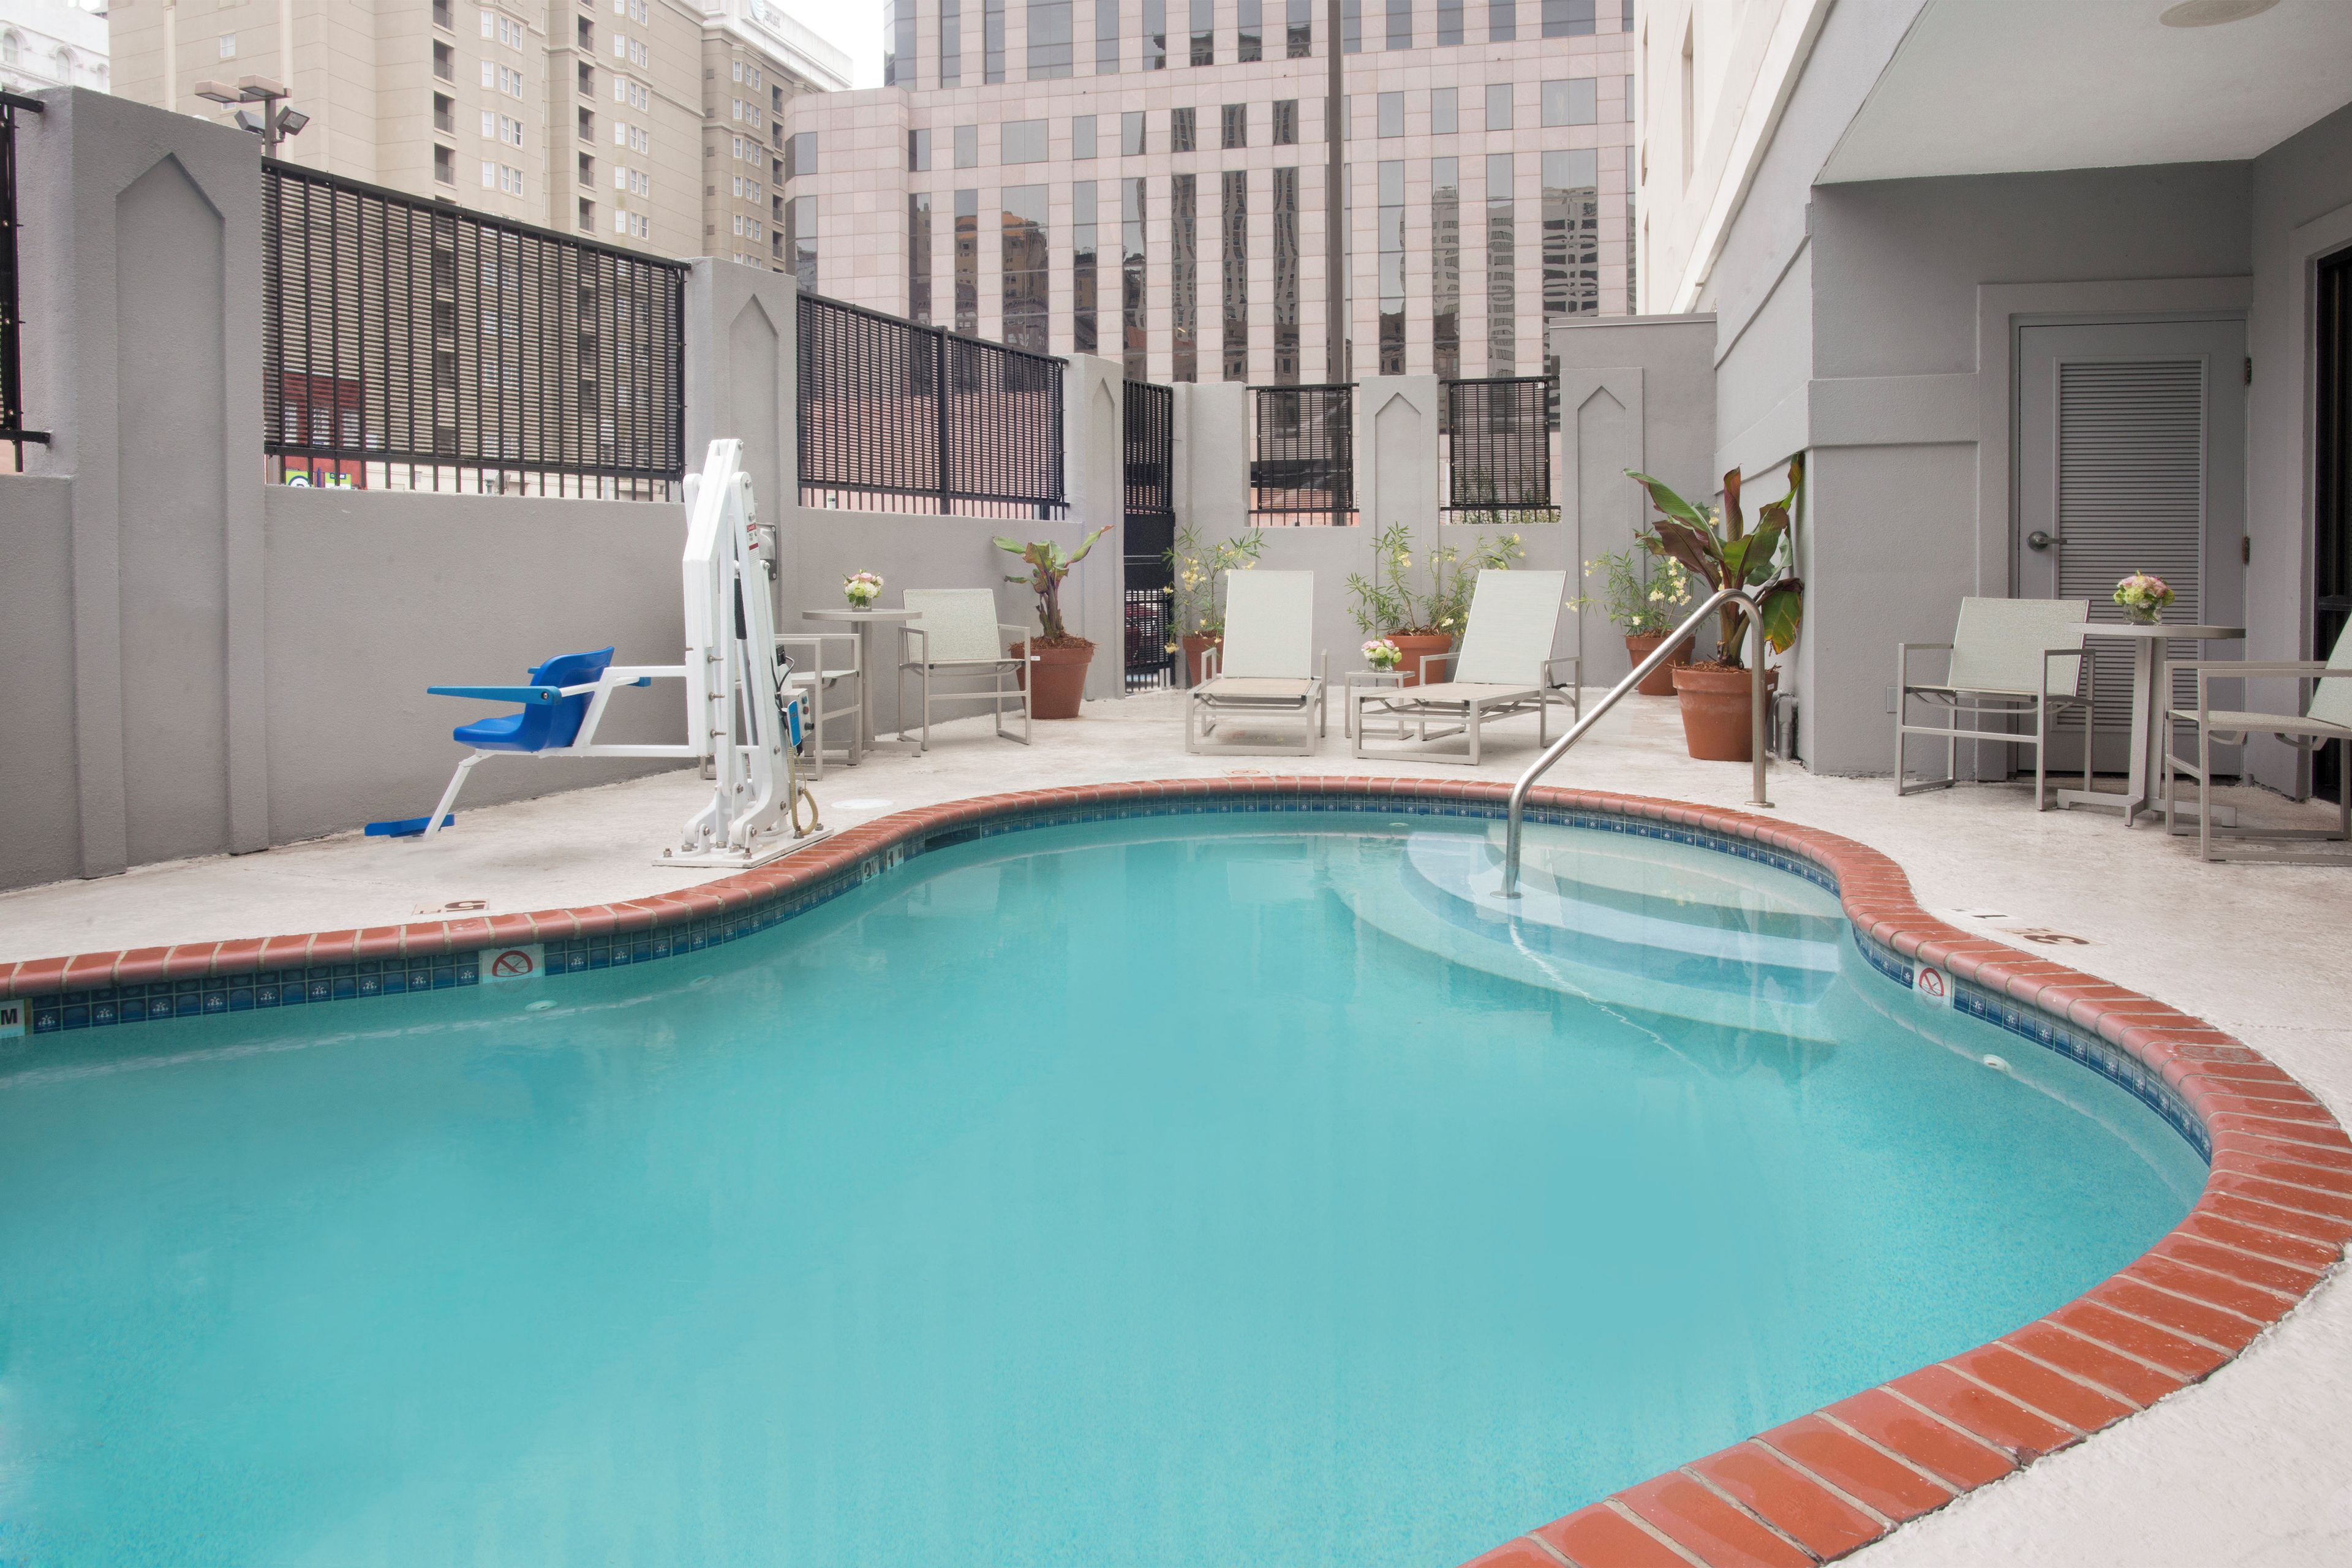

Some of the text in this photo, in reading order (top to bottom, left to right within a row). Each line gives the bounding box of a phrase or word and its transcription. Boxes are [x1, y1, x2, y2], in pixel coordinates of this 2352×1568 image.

[445, 900, 486, 912] 5
[2023, 934, 2090, 945] 3
[1, 1008, 18, 1025] M
